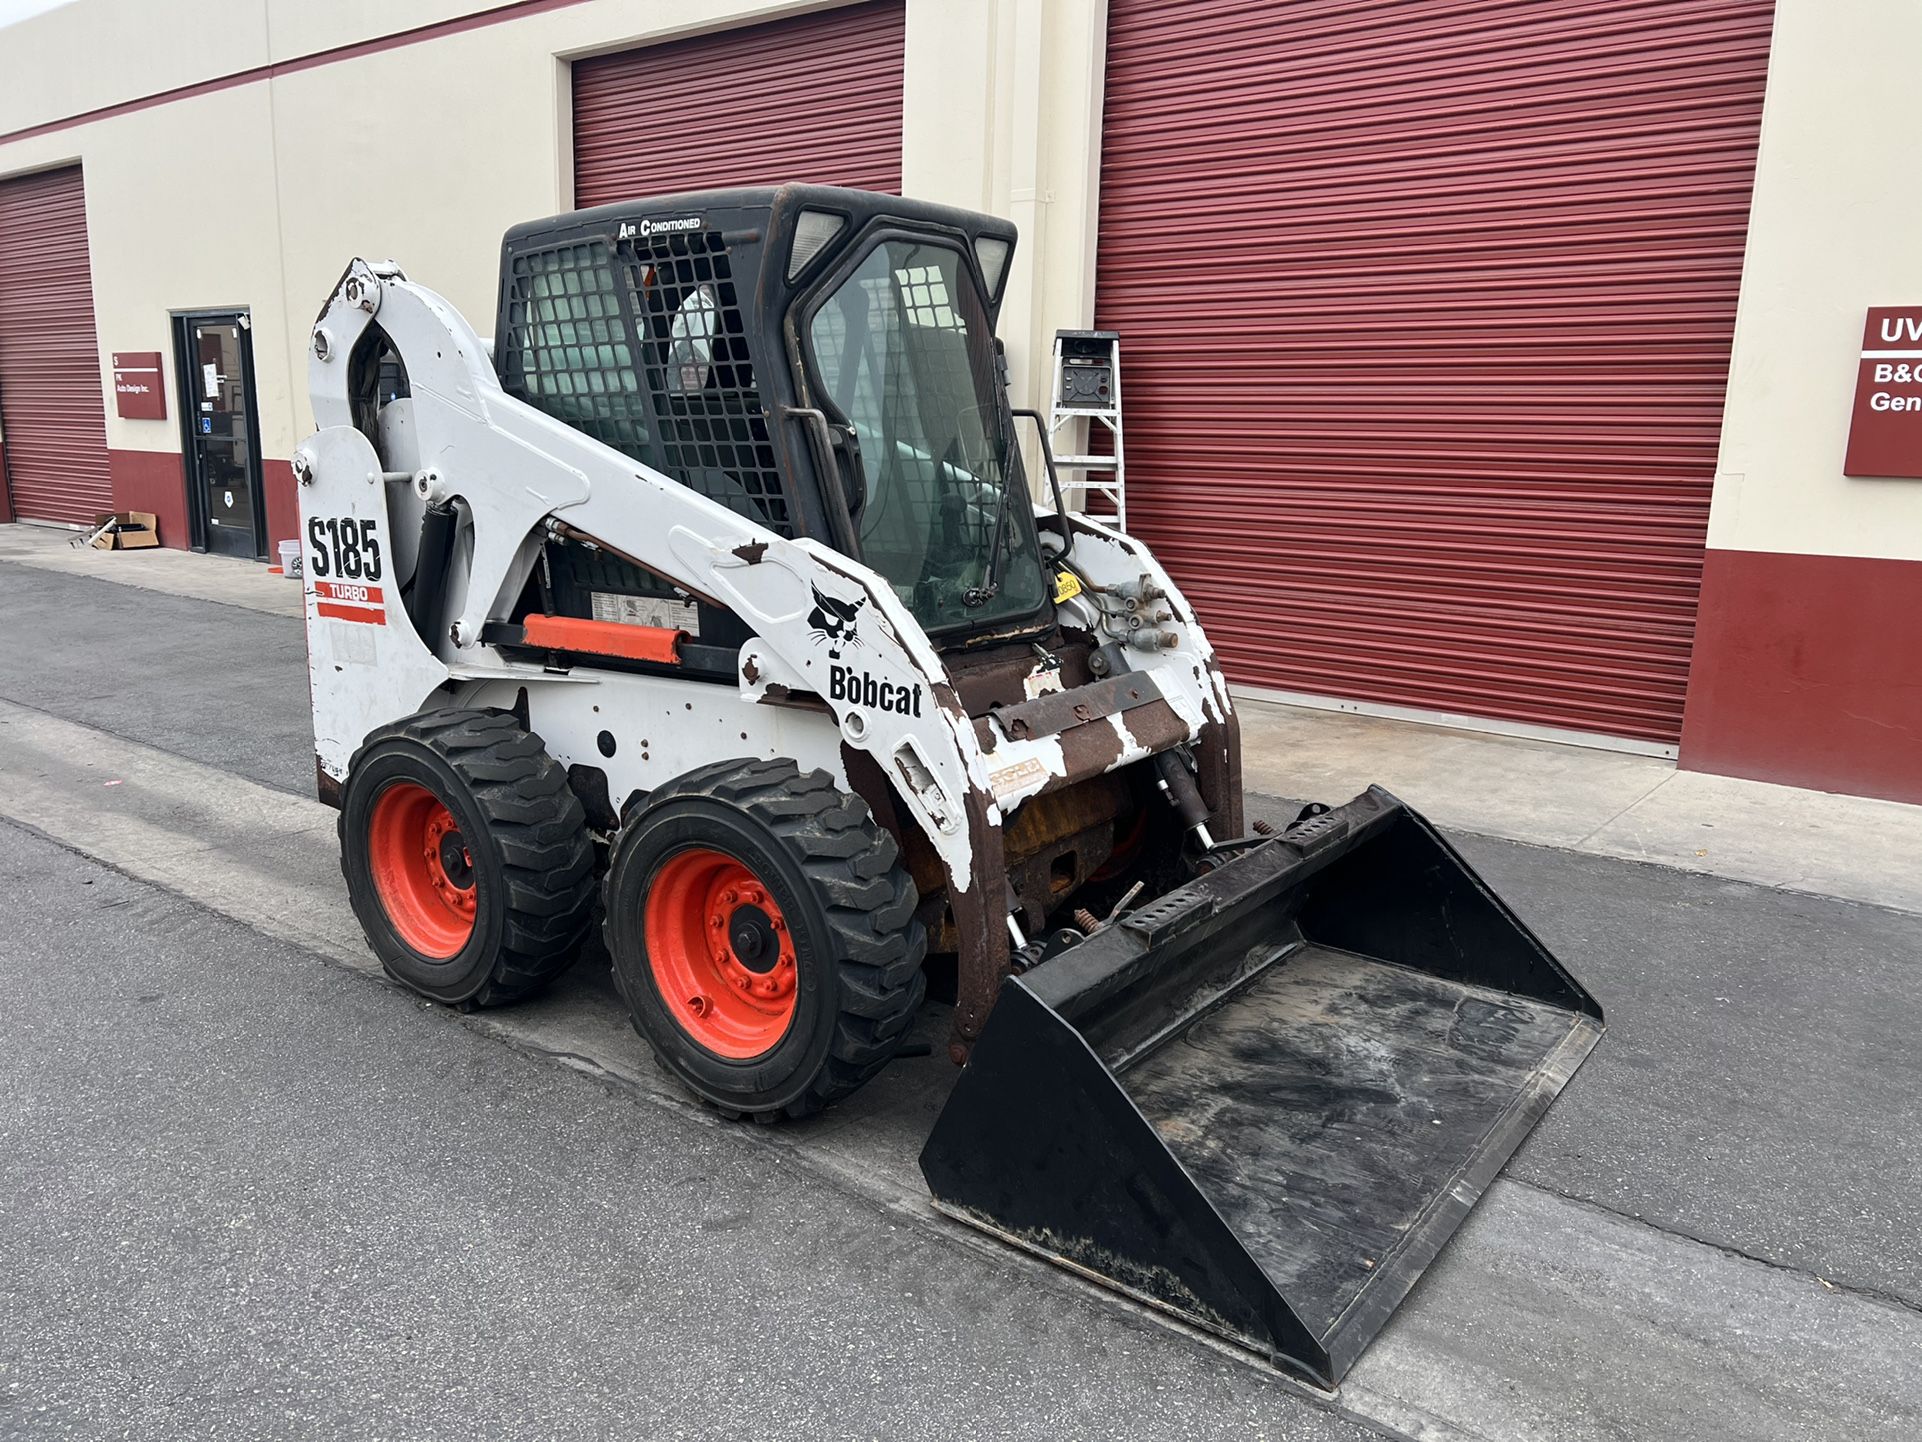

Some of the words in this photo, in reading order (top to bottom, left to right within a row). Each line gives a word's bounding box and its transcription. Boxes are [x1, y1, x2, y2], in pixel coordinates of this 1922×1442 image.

[1881, 317, 1922, 342] UV
[117, 384, 127, 392] Auto
[126, 384, 140, 394] Design
[1870, 391, 1922, 412] Gen
[308, 516, 382, 582] S185
[329, 583, 368, 601] TURBO
[829, 664, 922, 719] Bobcat
